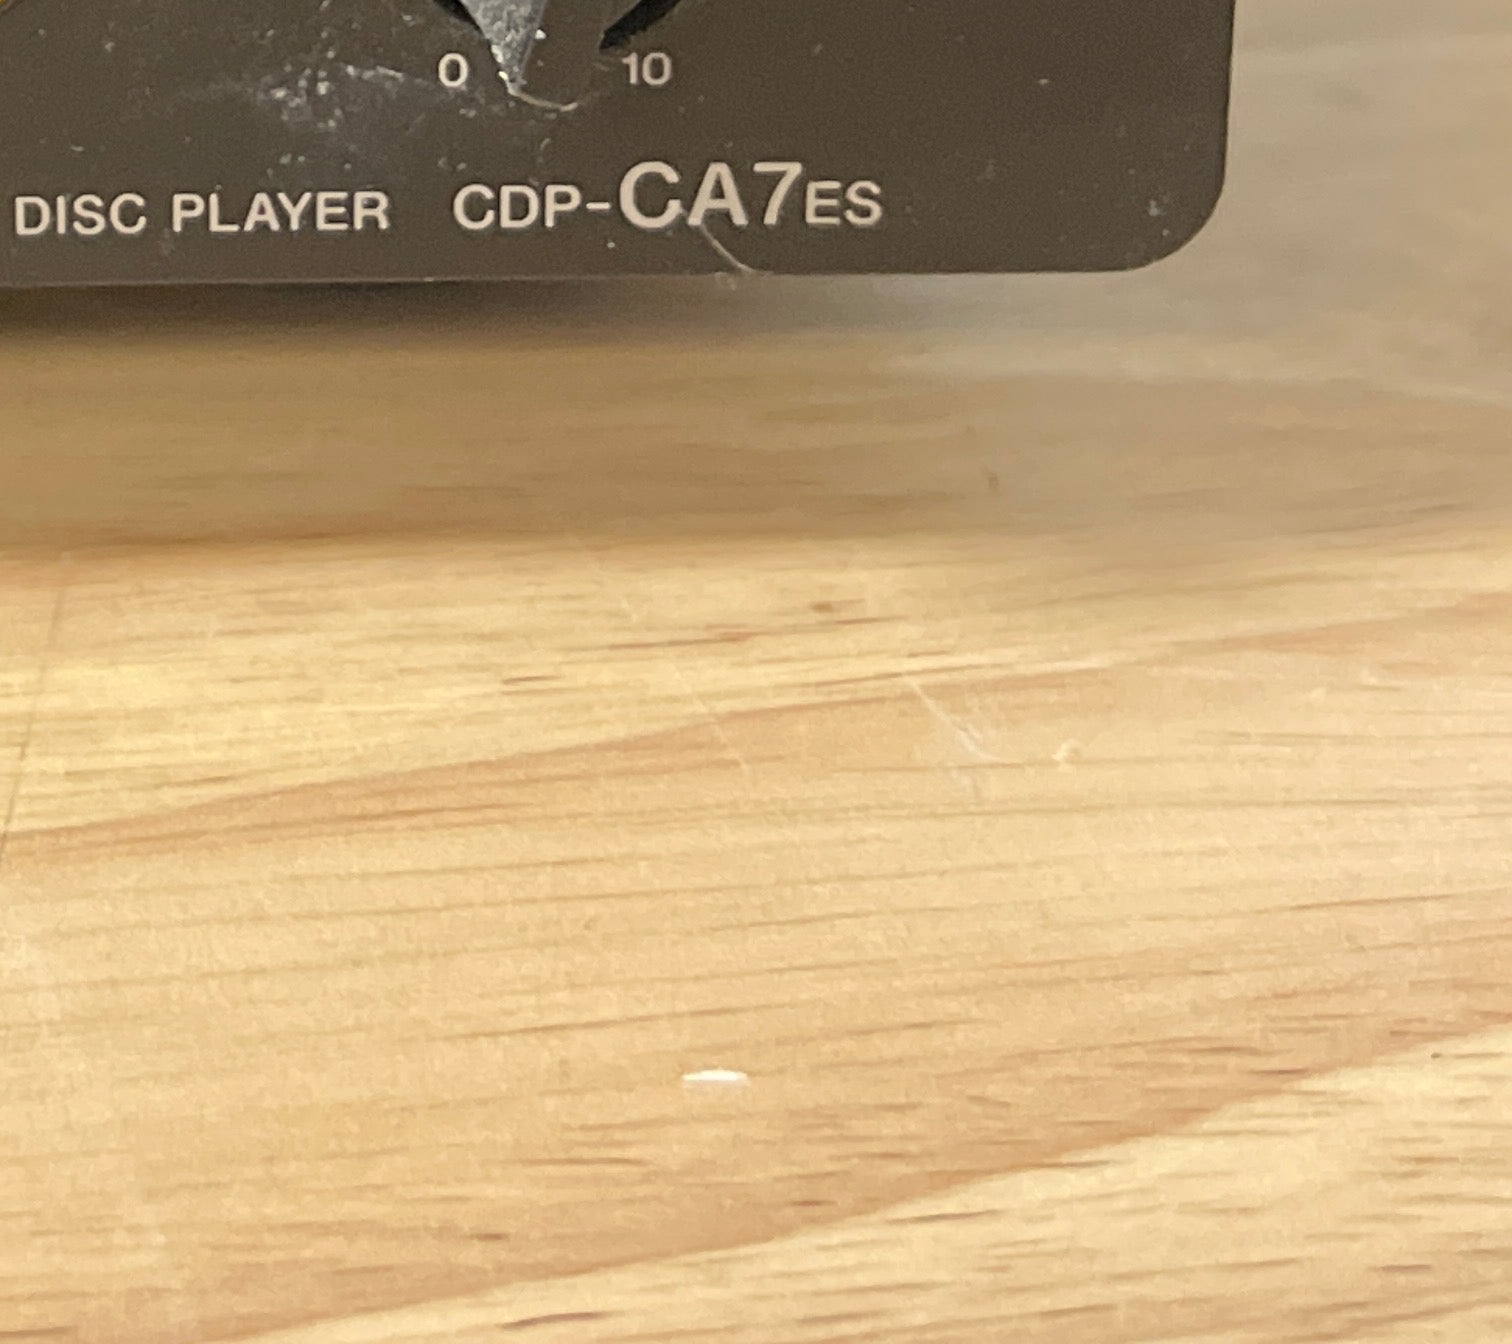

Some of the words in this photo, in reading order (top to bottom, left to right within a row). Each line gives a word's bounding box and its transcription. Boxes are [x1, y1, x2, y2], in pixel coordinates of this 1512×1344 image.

[438, 53, 469, 88] 0
[622, 52, 672, 85] 10
[14, 192, 147, 236] DISC
[172, 190, 389, 232] PLAYER
[452, 161, 882, 230] CDP-CA7ES
